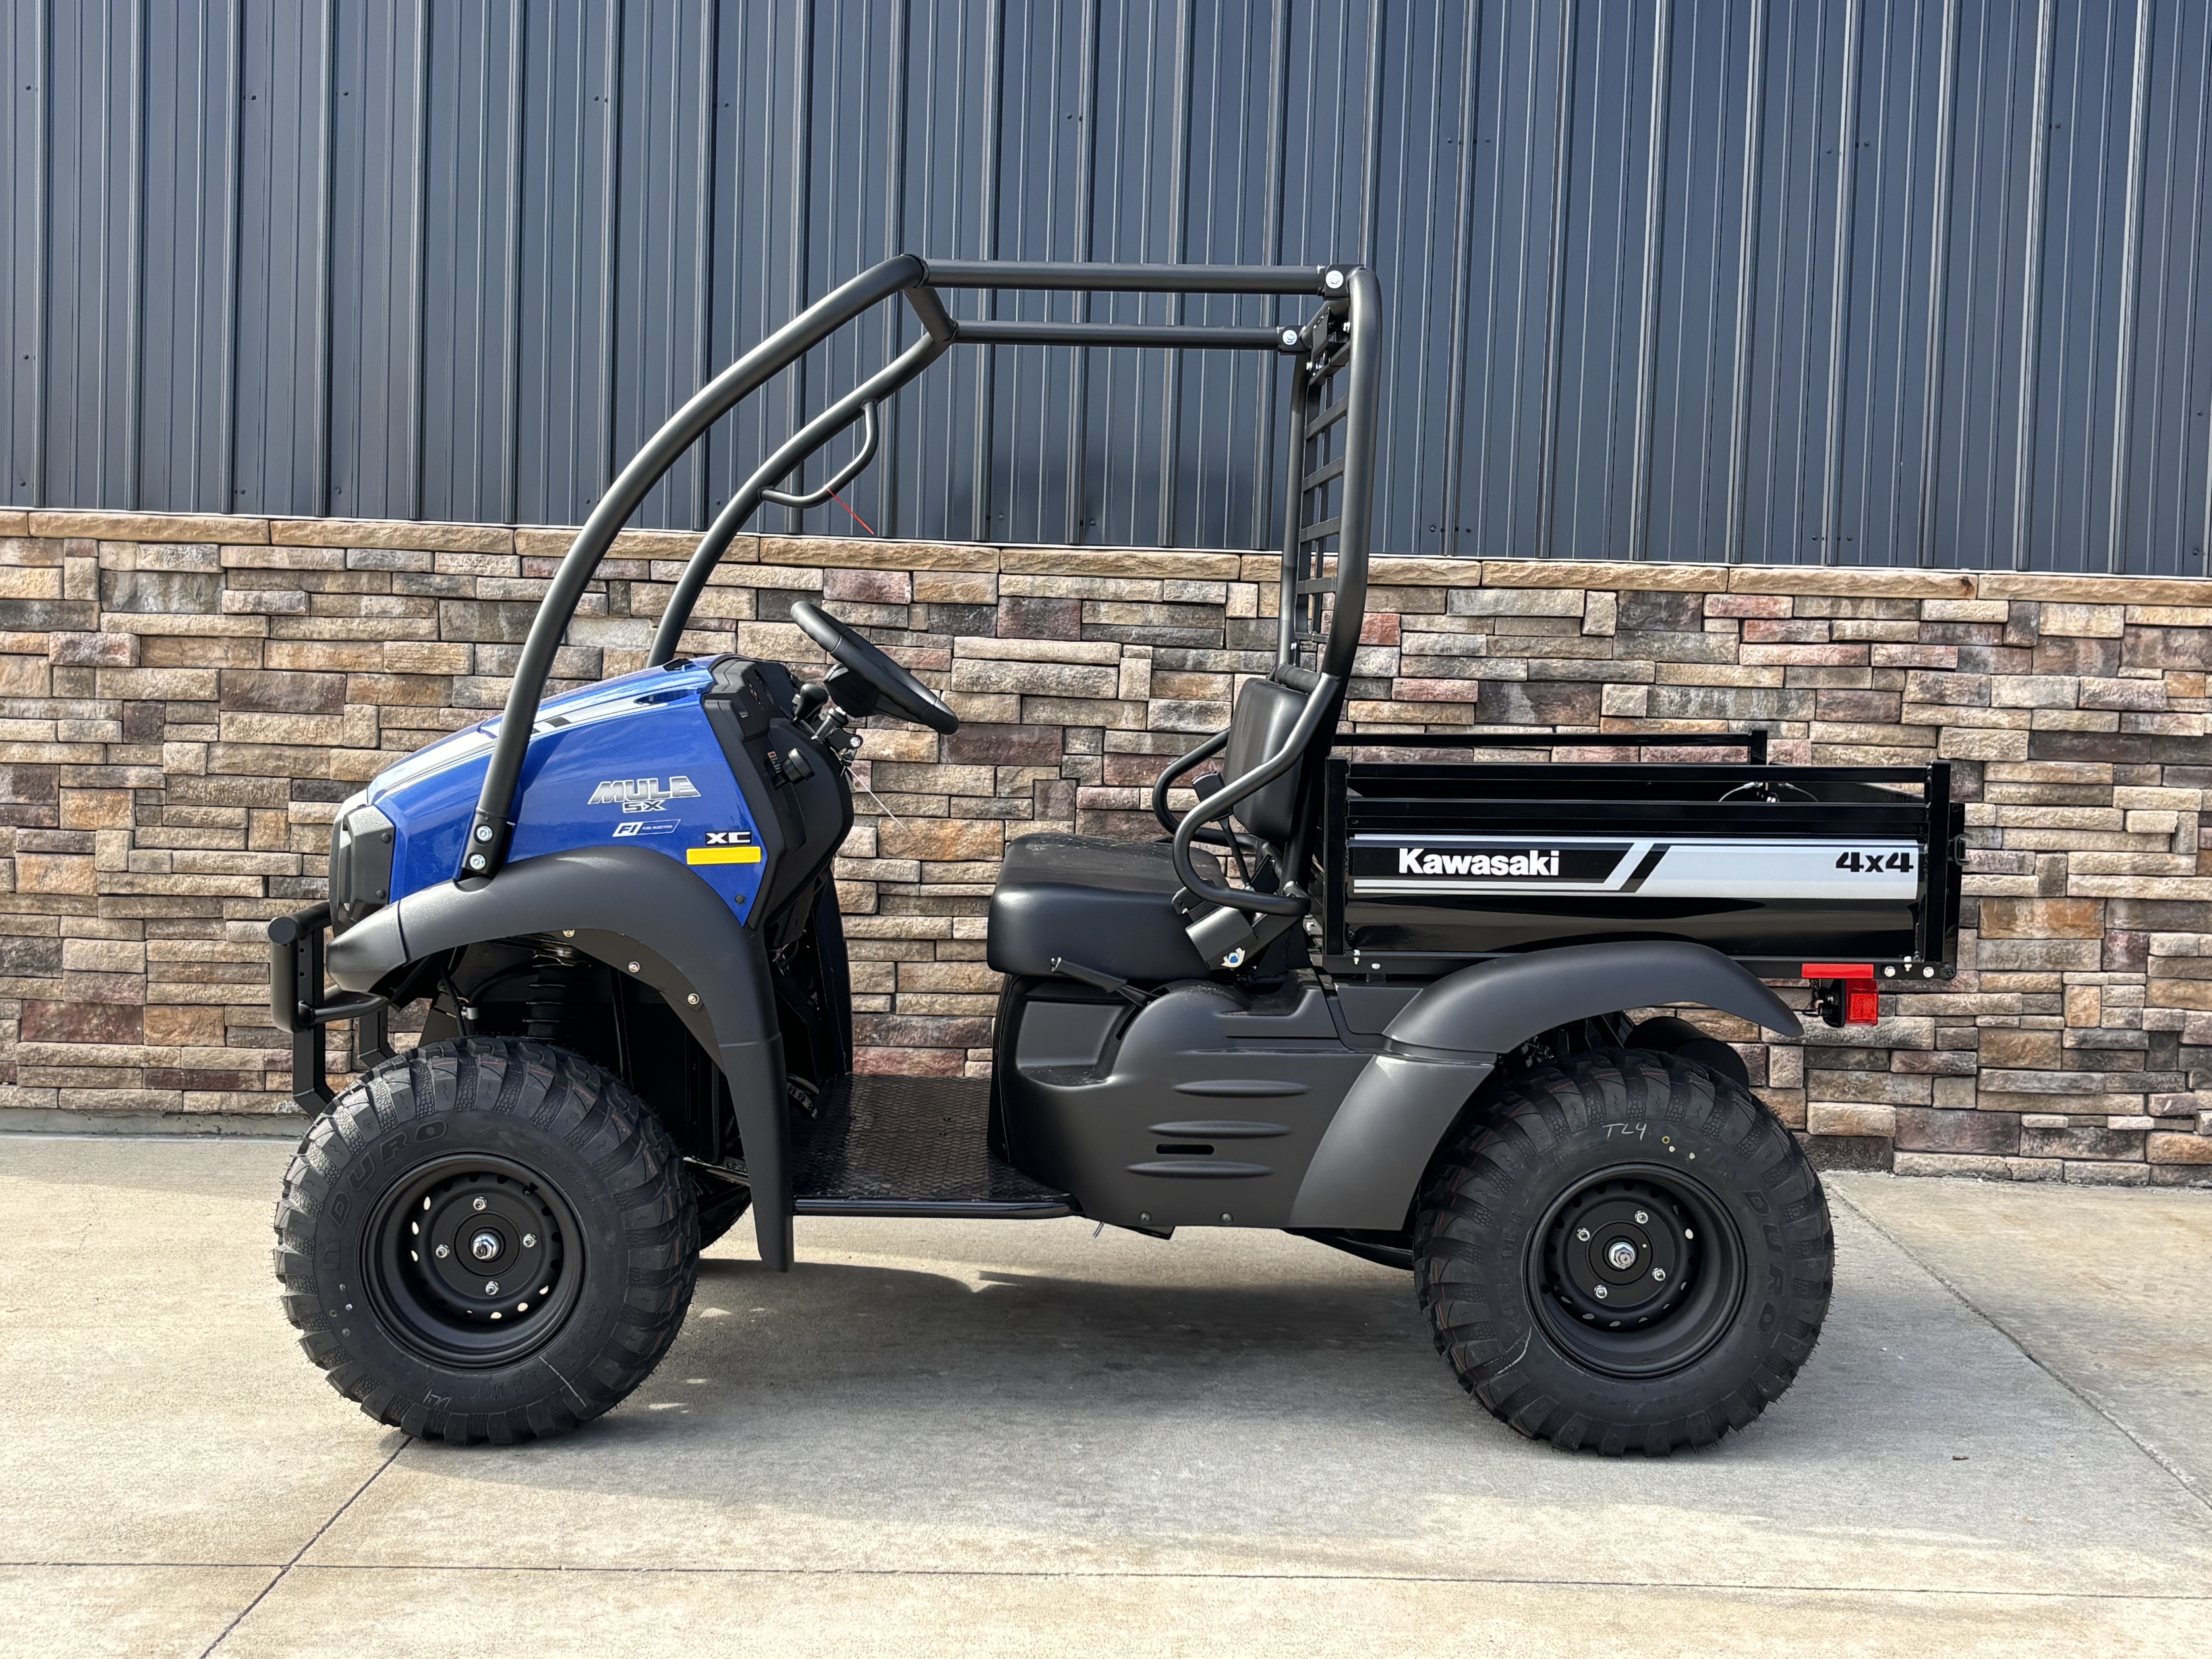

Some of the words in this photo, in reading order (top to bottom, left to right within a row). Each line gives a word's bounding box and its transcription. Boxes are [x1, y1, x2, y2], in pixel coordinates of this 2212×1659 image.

[588, 776, 701, 804] MULE
[622, 800, 667, 813] SX
[618, 824, 638, 834] FI
[706, 832, 750, 844] XC
[1399, 848, 1559, 876] Kawasaki
[1836, 852, 1914, 872] 4x4
[329, 1119, 447, 1228] DURO
[1743, 1190, 1785, 1334] DURO
